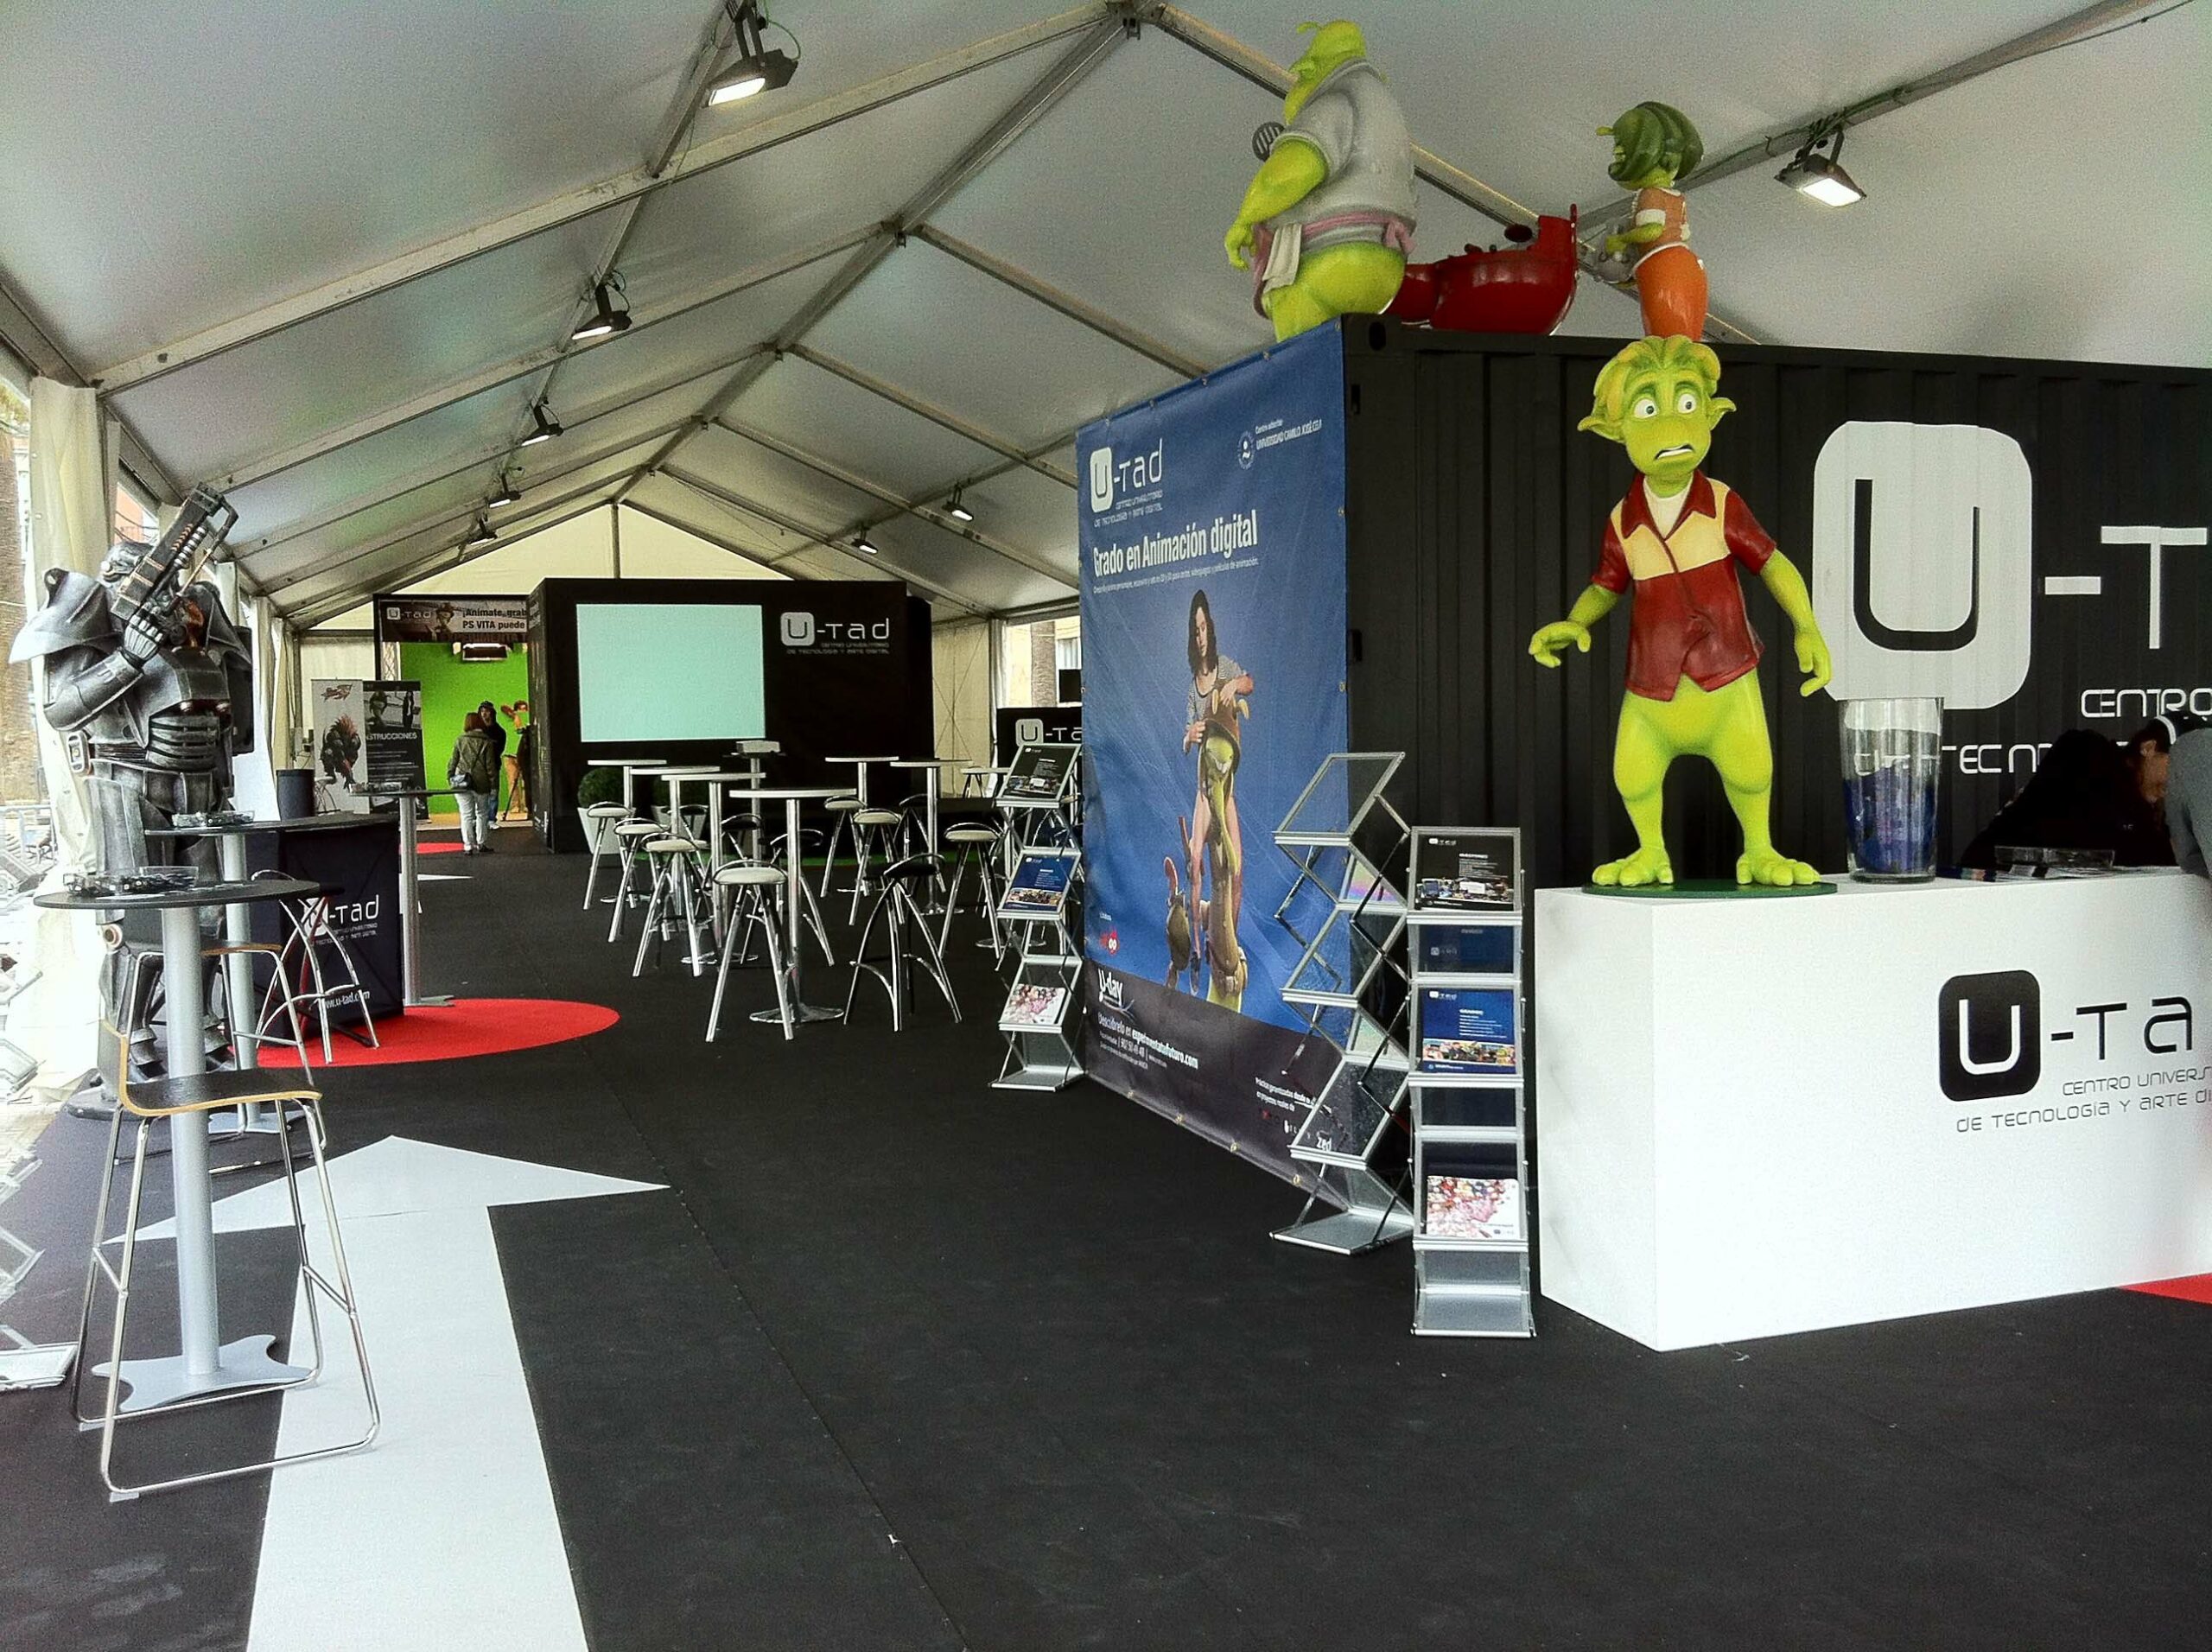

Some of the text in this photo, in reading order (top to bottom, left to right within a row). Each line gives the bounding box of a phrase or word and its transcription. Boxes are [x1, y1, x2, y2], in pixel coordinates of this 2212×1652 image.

[1093, 543, 1124, 578] Grado
[1126, 545, 1141, 571] en
[1141, 522, 1207, 569] Animación
[1210, 509, 1258, 559] digital
[462, 620, 525, 630] PS VITA puede
[786, 617, 890, 639] U-Tad
[365, 732, 417, 740] STRUCCIONES
[2119, 1099, 2131, 1112] Y
